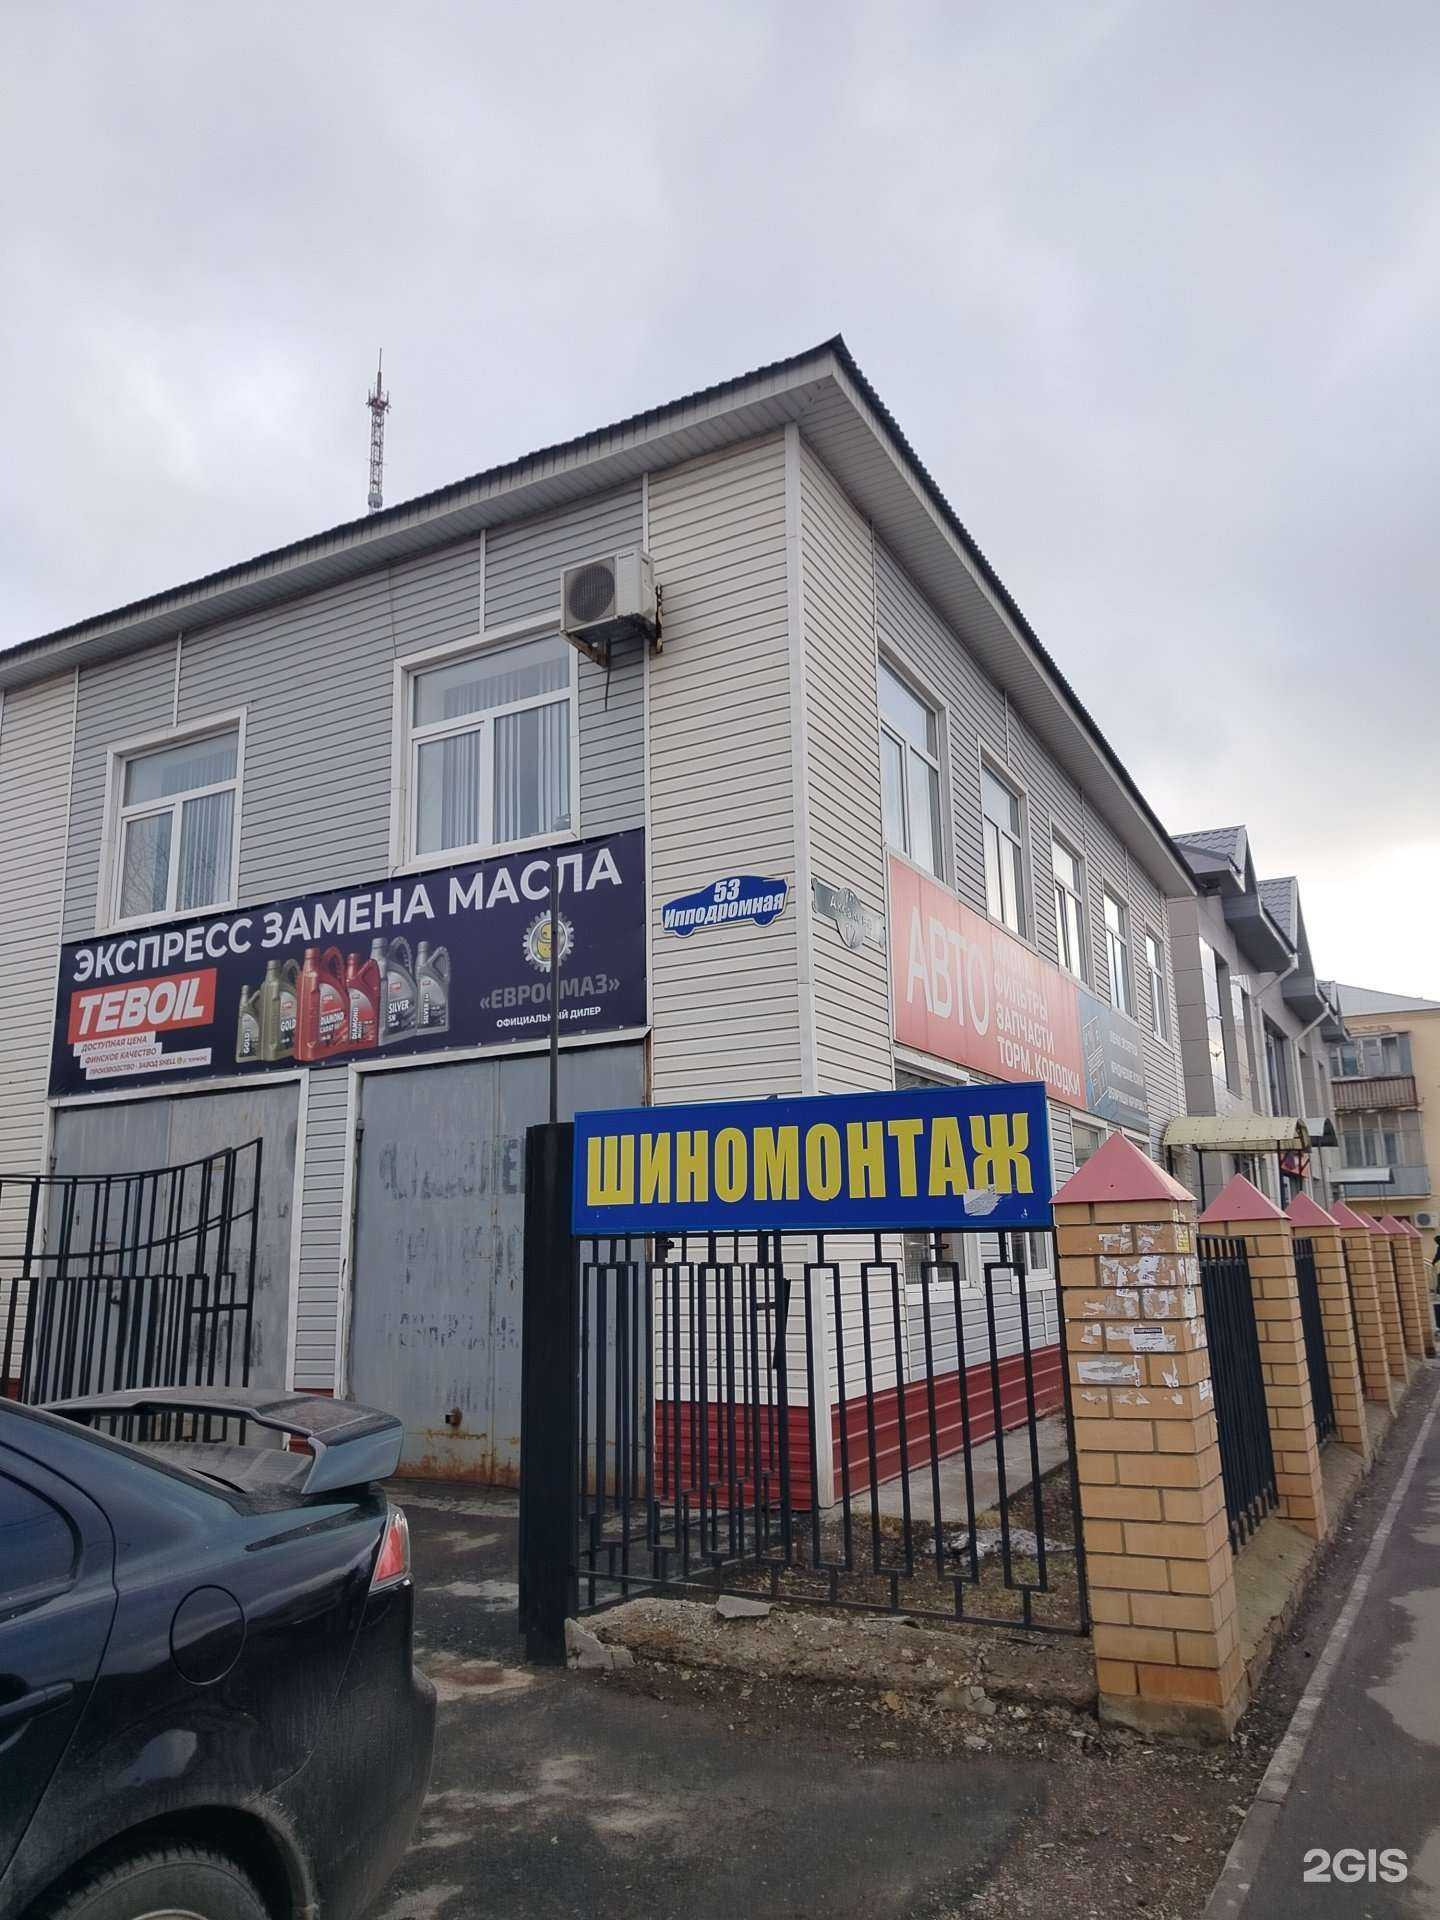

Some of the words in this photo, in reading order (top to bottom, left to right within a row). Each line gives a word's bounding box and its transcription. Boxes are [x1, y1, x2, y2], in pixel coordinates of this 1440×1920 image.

[714, 878, 741, 903] 53
[73, 918, 253, 982] ЭКСПРЕСС
[261, 884, 435, 948] ЗАМЕНА
[449, 848, 623, 915] МАСЛА
[664, 892, 785, 929] Ипподромная
[906, 906, 991, 1036] АВТО
[78, 977, 205, 1035] TEBOIL
[570, 1006, 602, 1019] ДИЛЕР
[81, 1038, 126, 1053] ДОСТУПНАЯ
[127, 1035, 147, 1047] ЦЕНА
[281, 1019, 297, 1032] GOLD
[996, 1004, 1056, 1055] ЗАПЧАСТИ
[119, 1048, 157, 1061] КАЧЕСТВО
[587, 1112, 1034, 1206] ШИНОМОНТАЖ
